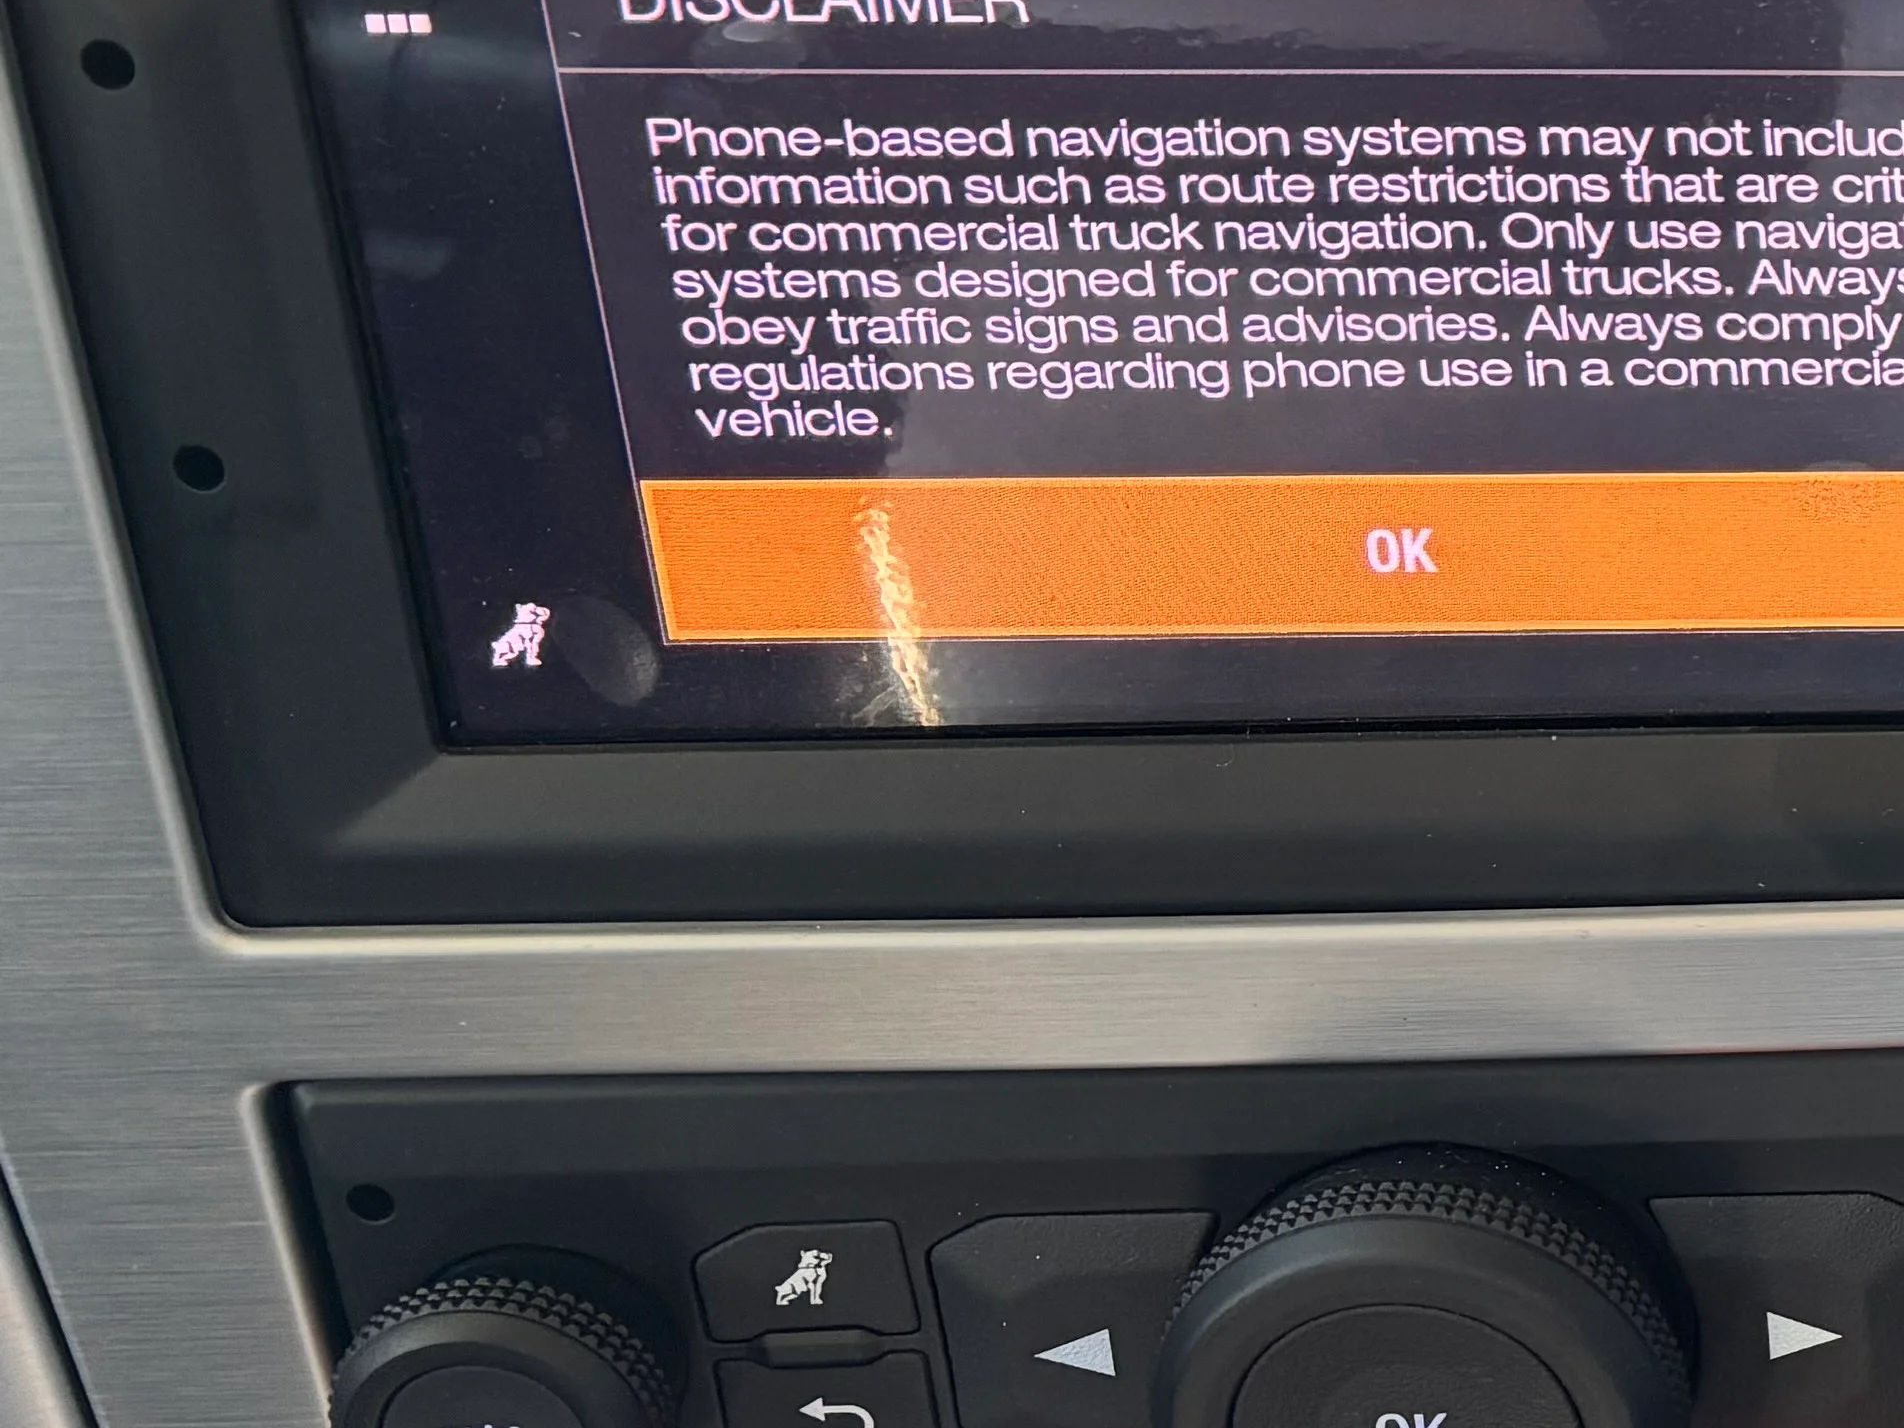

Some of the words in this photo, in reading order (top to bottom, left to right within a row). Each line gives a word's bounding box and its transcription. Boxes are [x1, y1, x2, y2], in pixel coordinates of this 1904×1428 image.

[645, 117, 1014, 157] Phone-based
[1026, 118, 1290, 167] navigation
[1303, 118, 1527, 167] systems
[1539, 126, 1654, 167] may
[1666, 119, 1753, 157] not
[653, 166, 953, 205] information
[964, 166, 1092, 205] such
[1104, 174, 1166, 204] as
[1179, 166, 1315, 204] route
[1329, 165, 1611, 203] restrictions
[1620, 165, 1725, 203] that
[1736, 173, 1819, 203] are
[660, 213, 738, 252] for
[749, 213, 1060, 252] commercial
[1068, 212, 1204, 251] truck
[1214, 212, 1487, 260] navigation.
[1501, 212, 1615, 260] Only
[1627, 220, 1722, 249] use
[672, 262, 902, 309] systems
[914, 259, 1156, 308] designed
[1165, 259, 1239, 297] for
[1249, 258, 1552, 297] commercial
[1561, 258, 1734, 296] trucks.
[682, 308, 816, 355] obey
[826, 307, 972, 345] traffic
[985, 306, 1119, 354] signs
[1132, 305, 1229, 343] and
[1242, 305, 1510, 343] advisories.
[1524, 304, 1704, 352] Always
[1716, 304, 1903, 352] comply
[688, 352, 975, 401] regulations
[987, 351, 1230, 400] regarding
[1242, 351, 1406, 399] phone
[1419, 358, 1513, 387] use
[1525, 350, 1568, 387] in
[1580, 358, 1613, 387] a
[695, 398, 893, 438] vehicle.
[1366, 527, 1439, 573] OK
